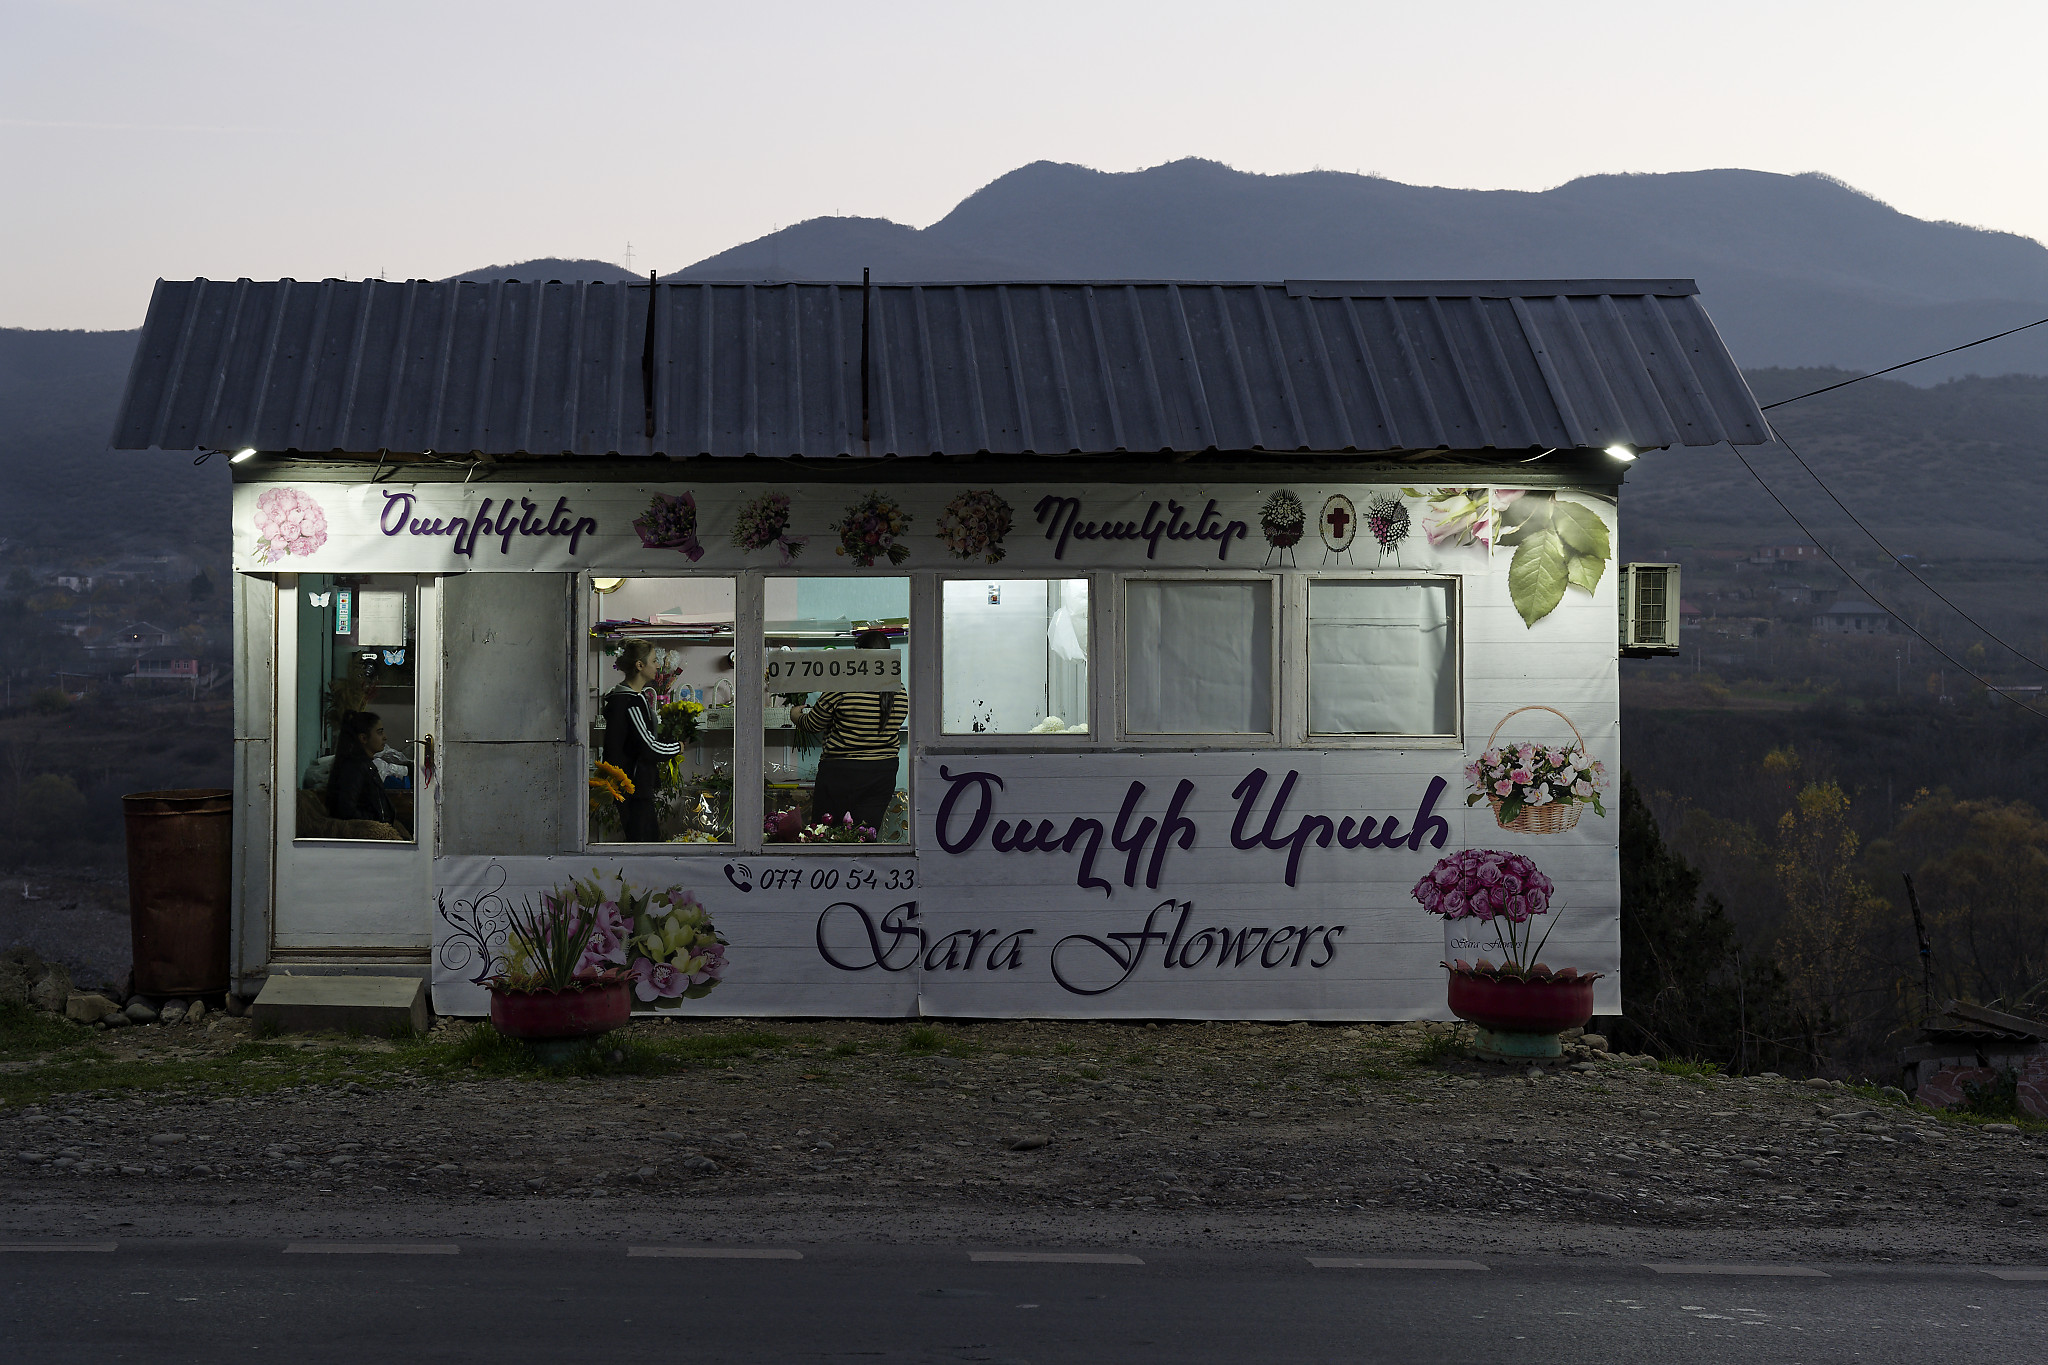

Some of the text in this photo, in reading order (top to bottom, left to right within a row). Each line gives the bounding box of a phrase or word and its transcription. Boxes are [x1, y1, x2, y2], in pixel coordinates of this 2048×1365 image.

[380, 490, 596, 559] Ծաղիկներ
[1033, 494, 1247, 560] Պսակներ
[935, 765, 1197, 899] Ծաղկի
[760, 869, 915, 890] 077 00 54 33
[816, 899, 1345, 996] Sara Flowers
[1451, 939, 1480, 948] Sara
